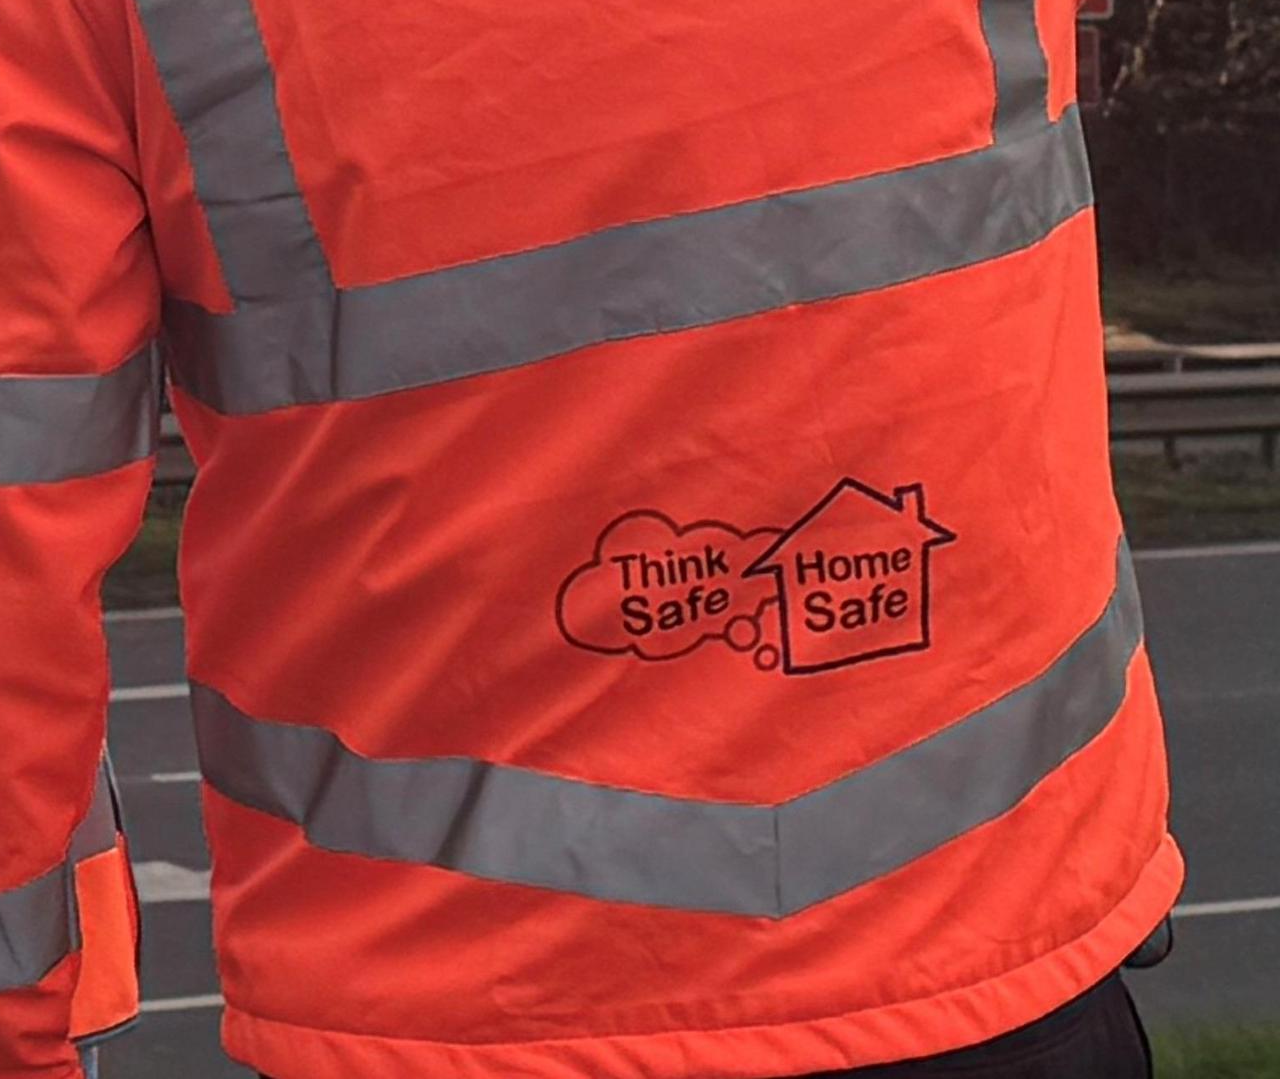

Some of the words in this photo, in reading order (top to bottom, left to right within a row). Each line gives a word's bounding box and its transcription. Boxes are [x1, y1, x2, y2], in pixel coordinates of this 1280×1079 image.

[610, 544, 730, 591] Think
[795, 545, 913, 586] Home
[620, 584, 730, 637] Safe
[803, 582, 910, 633] Safe
